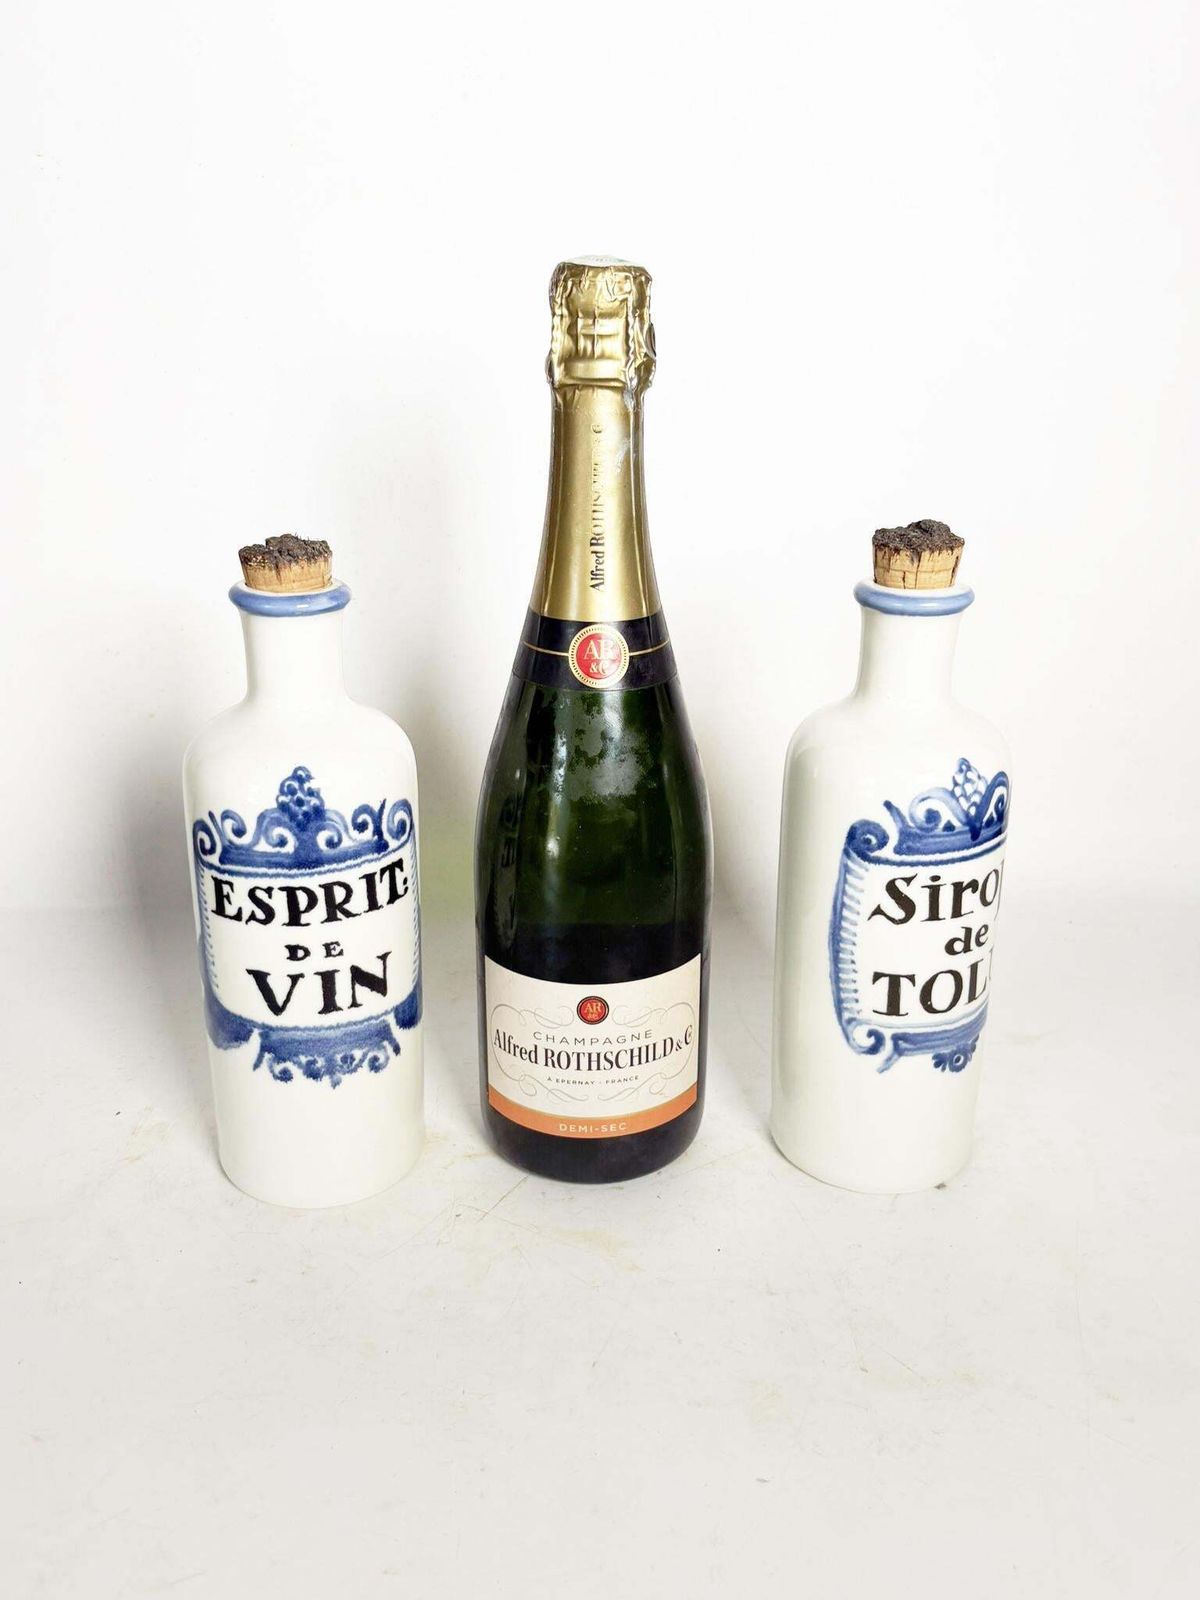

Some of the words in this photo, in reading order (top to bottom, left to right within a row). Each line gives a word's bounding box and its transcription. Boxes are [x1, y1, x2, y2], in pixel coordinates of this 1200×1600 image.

[589, 551, 605, 592] Alfred
[583, 639, 617, 660] AR
[284, 941, 344, 961] DE
[944, 924, 989, 956] de
[245, 951, 392, 1016] VIN
[493, 1028, 539, 1065] Alfred
[533, 1029, 653, 1046] CHAMPAGNE
[559, 1122, 627, 1133] DEMI-SEC
